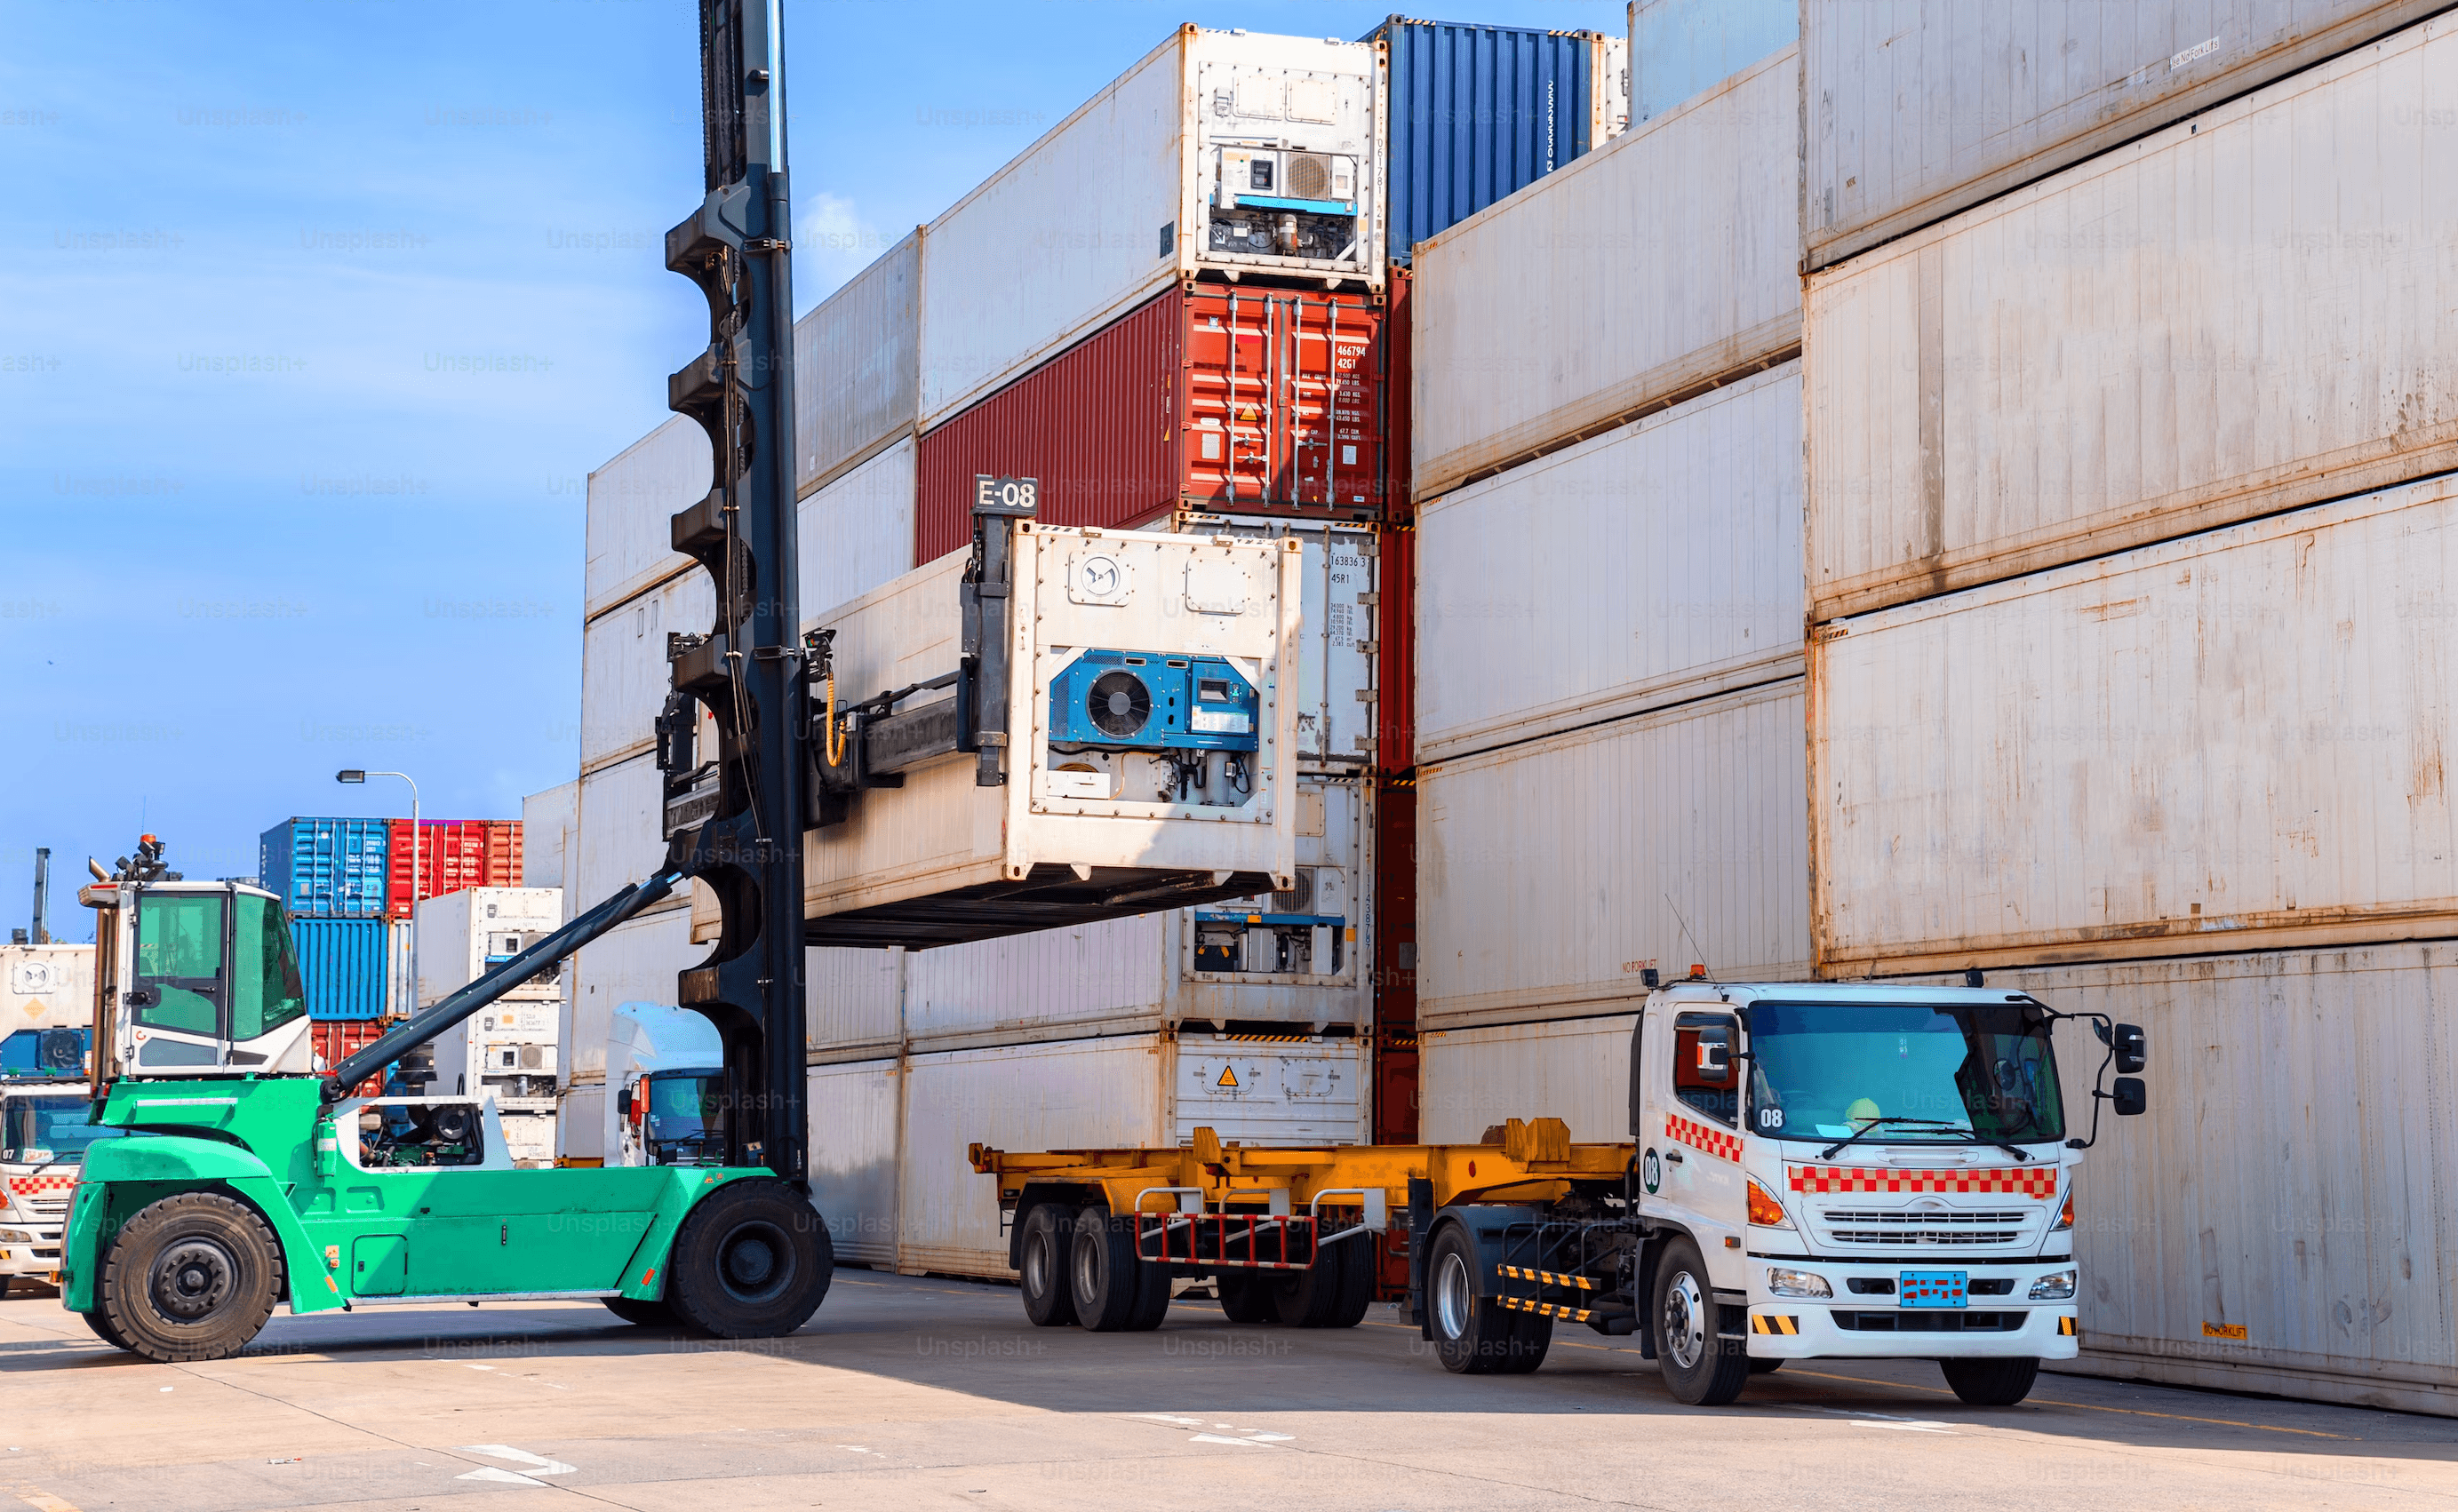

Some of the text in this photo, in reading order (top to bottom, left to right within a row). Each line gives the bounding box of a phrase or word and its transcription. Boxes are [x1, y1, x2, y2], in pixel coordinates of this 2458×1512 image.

[1337, 345, 1366, 356] 466794
[1337, 358, 1356, 369] 42G1
[978, 480, 1035, 508] E-08
[1331, 555, 1366, 567] 163836 3
[1331, 574, 1350, 584] 45R1
[1760, 1108, 1783, 1128] 08
[2, 1149, 14, 1160] 07
[1645, 1155, 1659, 1187] 08
